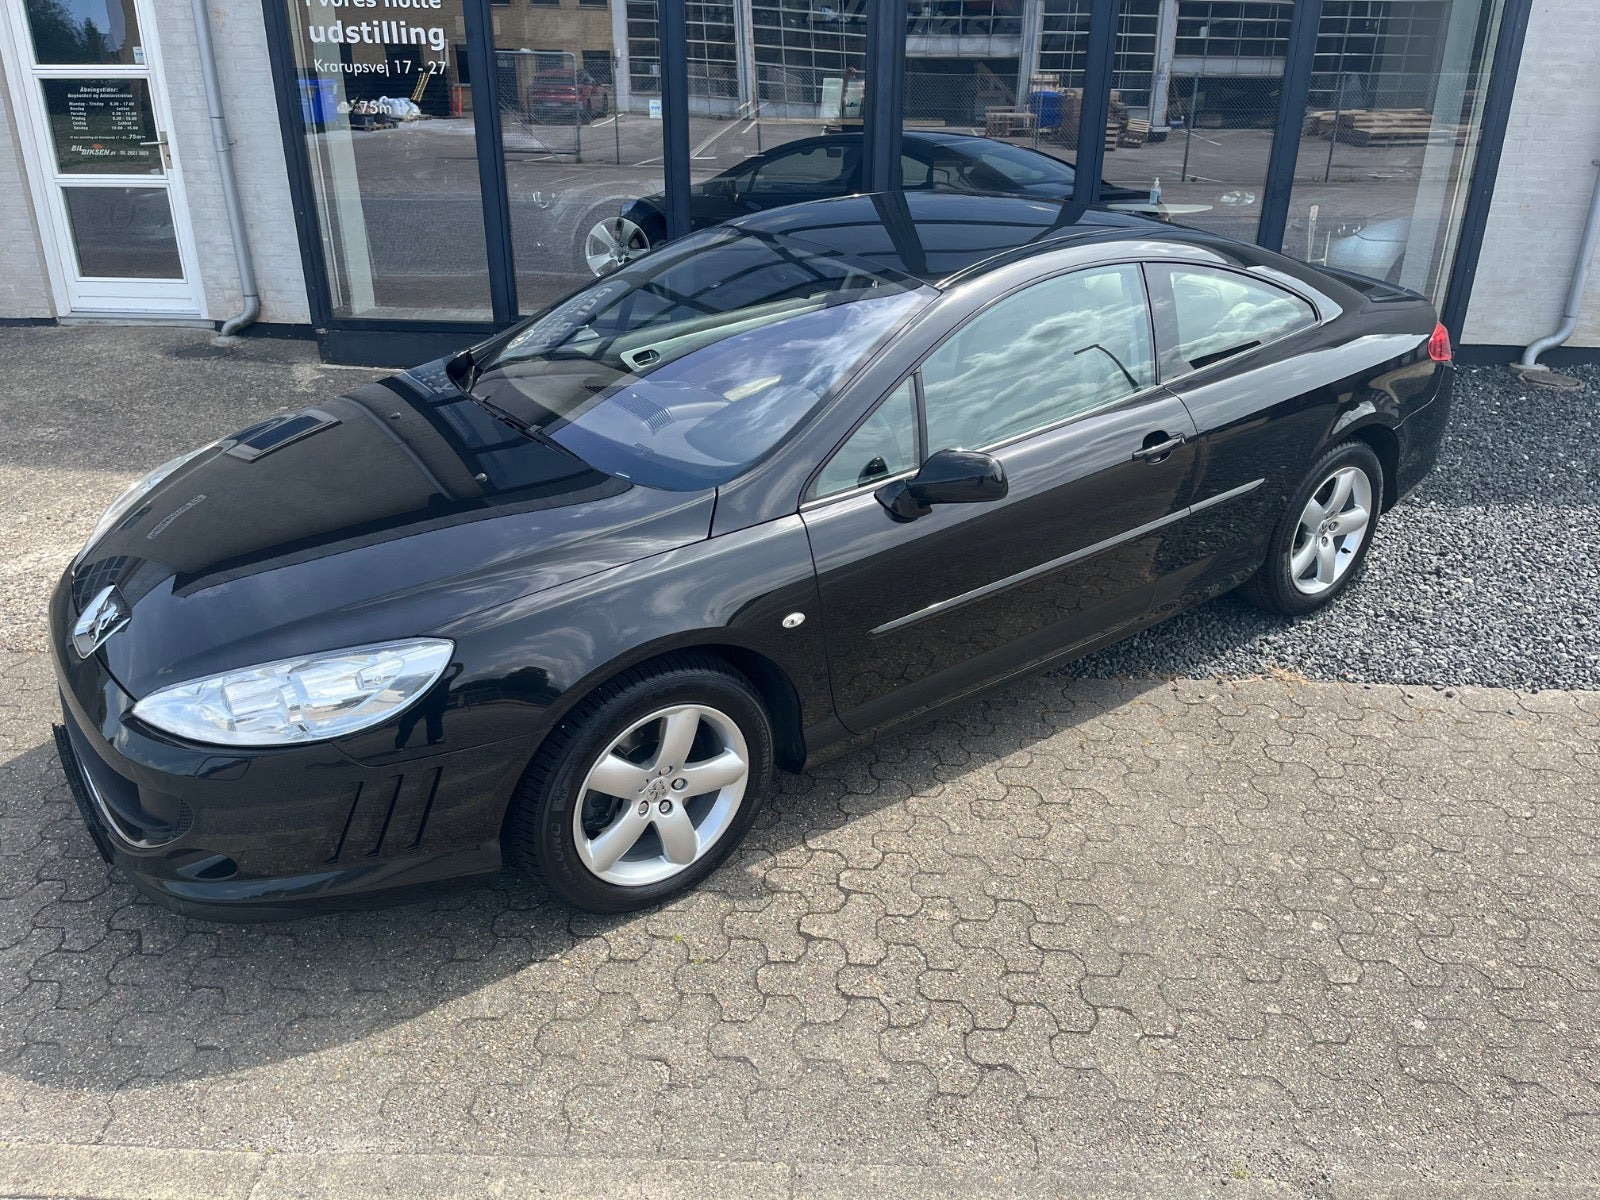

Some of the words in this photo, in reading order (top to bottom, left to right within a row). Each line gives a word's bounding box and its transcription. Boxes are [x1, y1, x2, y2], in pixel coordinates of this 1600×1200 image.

[308, 20, 446, 51] udstilling
[313, 58, 390, 78] Krarupsvej
[394, 60, 412, 74] 17
[428, 60, 447, 75] 27
[360, 100, 392, 114] 75m
